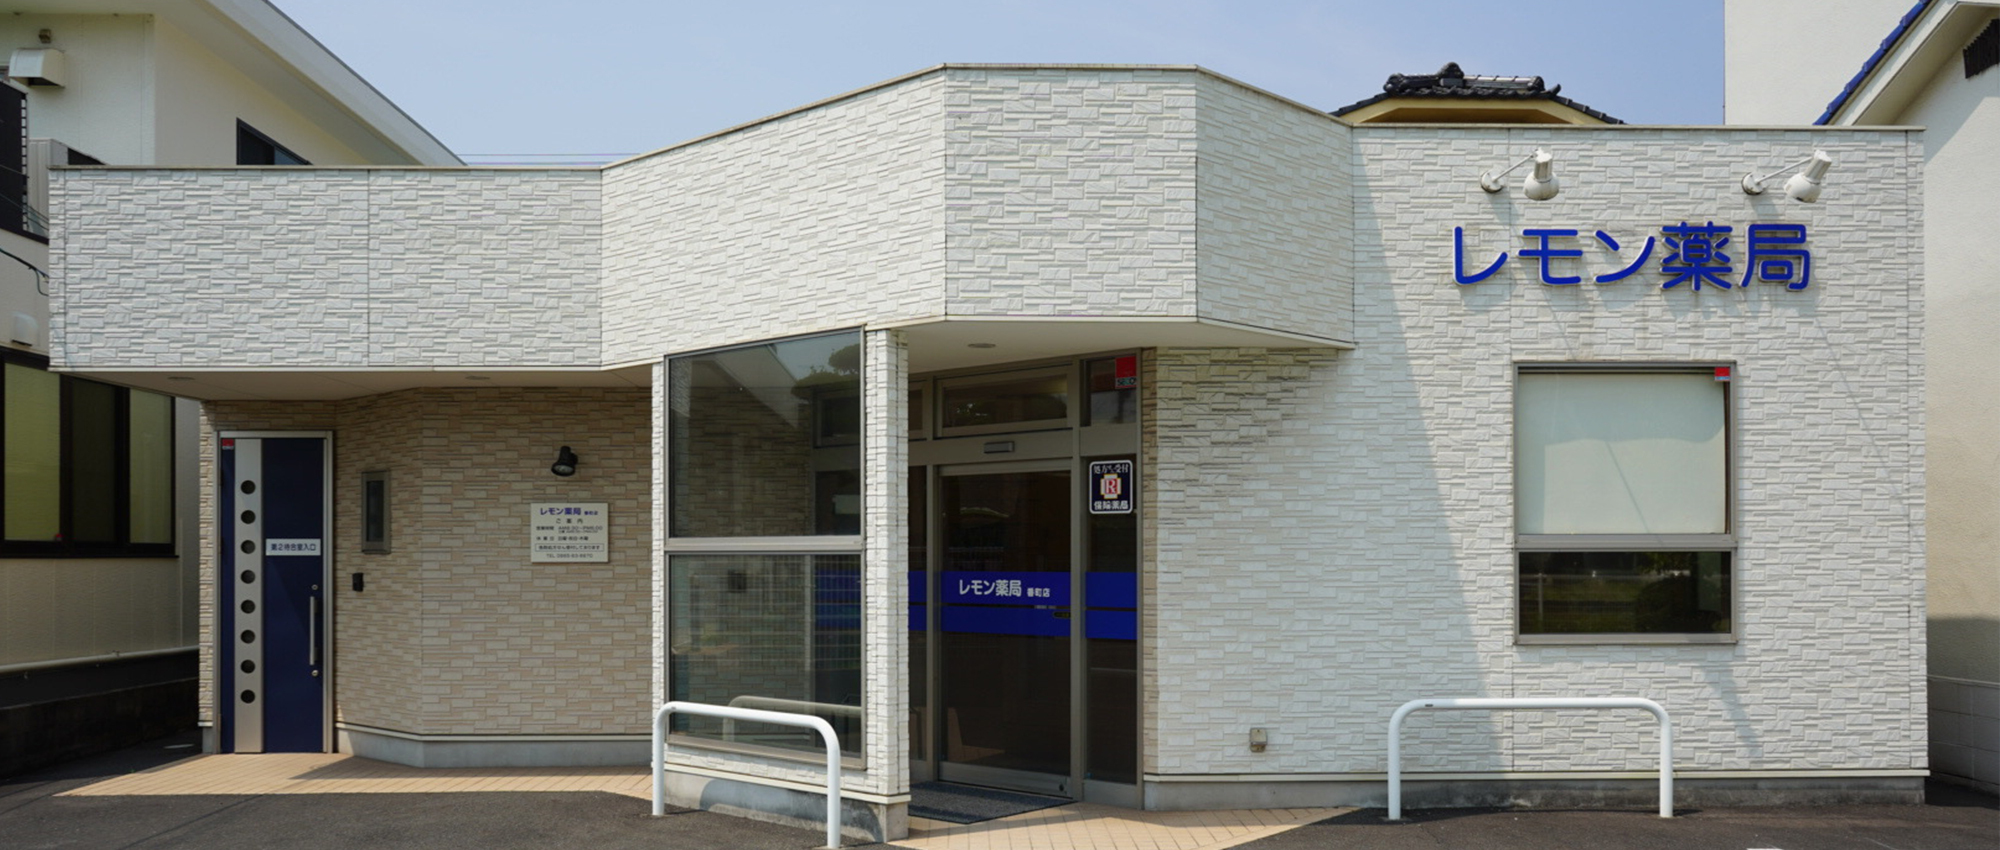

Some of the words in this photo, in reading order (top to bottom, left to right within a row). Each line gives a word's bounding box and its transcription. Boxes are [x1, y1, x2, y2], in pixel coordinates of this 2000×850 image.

[1454, 221, 1811, 292] レモン薬局
[540, 507, 582, 515] レモン薬局
[959, 579, 1022, 597] レモン薬局
[1027, 587, 1050, 597] 番町店
